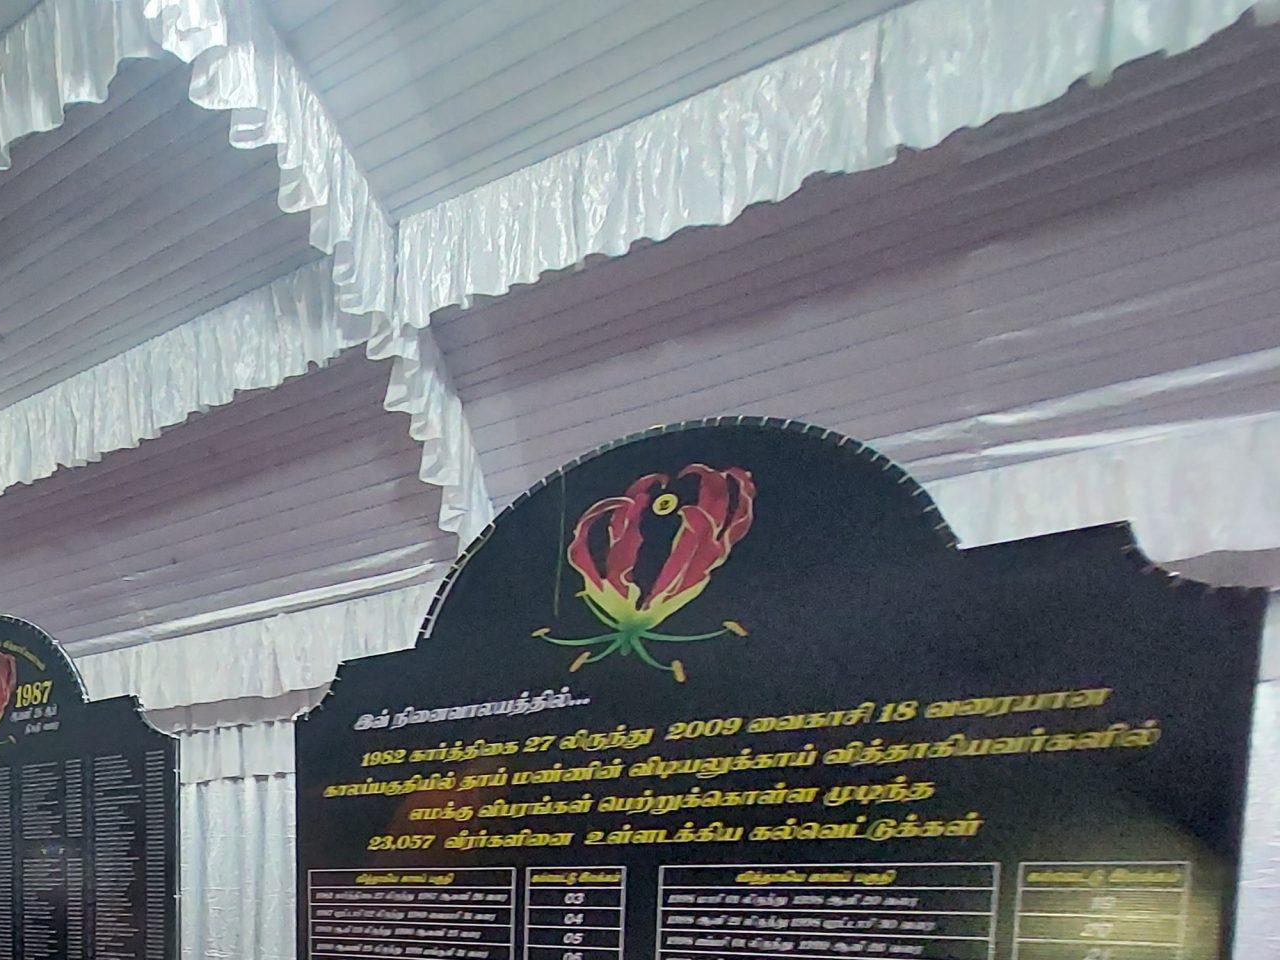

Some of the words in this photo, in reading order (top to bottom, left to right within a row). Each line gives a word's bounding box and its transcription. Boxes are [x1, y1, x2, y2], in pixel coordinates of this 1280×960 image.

[15, 680, 53, 708] 1987
[361, 749, 406, 768] 1982
[408, 739, 519, 764] கார்த்திகை
[523, 735, 557, 754] 27
[664, 717, 744, 741] 2009
[746, 701, 876, 734] வைகாசி
[876, 700, 919, 723] 18
[458, 767, 508, 792] தாய்
[564, 892, 585, 905] 03
[564, 913, 584, 926] 04
[563, 933, 584, 945] 05
